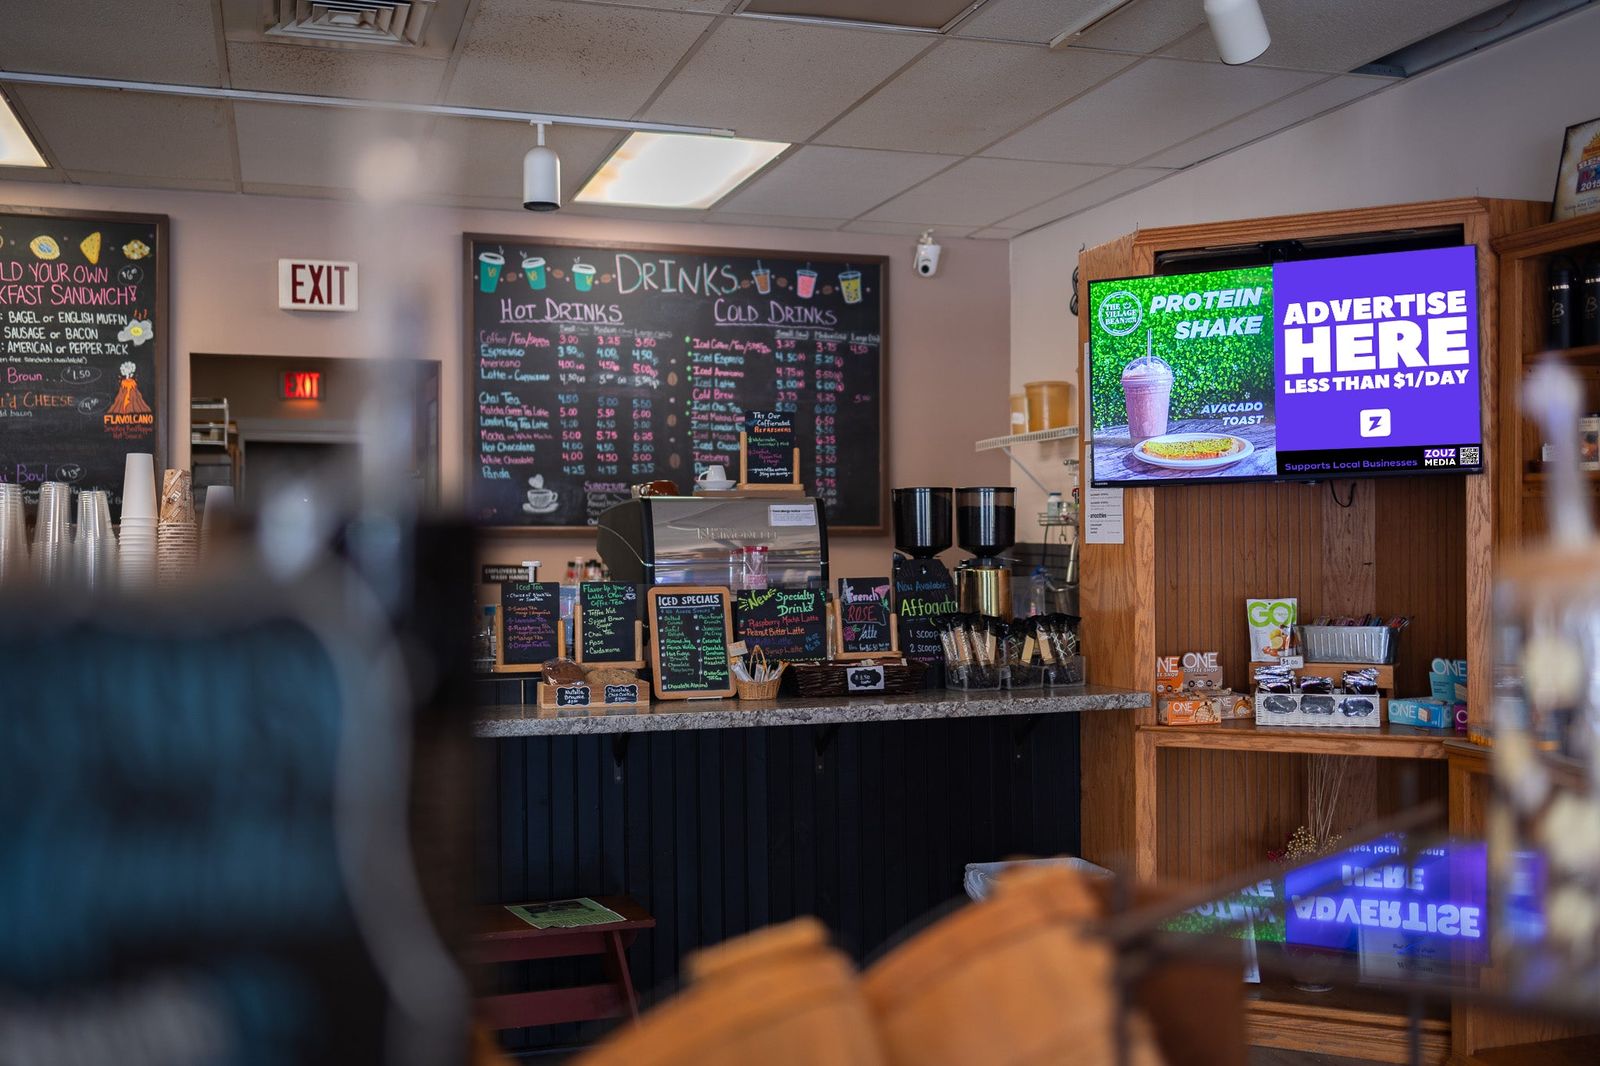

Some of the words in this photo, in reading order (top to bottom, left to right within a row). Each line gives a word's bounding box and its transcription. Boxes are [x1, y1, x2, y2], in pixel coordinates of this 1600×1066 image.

[28, 262, 71, 284] YOUR
[74, 265, 108, 284] OWN
[291, 264, 350, 306] EXIT
[1150, 287, 1262, 314] PROTEIN
[1283, 290, 1466, 326] ADVERTISE
[8, 310, 40, 324] BAGEL
[43, 315, 54, 324] or
[58, 311, 94, 324] ENGLISH
[96, 312, 128, 325] MUFFIN
[1105, 310, 1136, 318] VILLAGE
[4, 327, 46, 340] SAUSAGE
[50, 331, 61, 340] or
[66, 327, 98, 340] BACON
[1174, 316, 1263, 340] SHAKE
[8, 341, 52, 354] AMERICAN
[56, 345, 66, 354] or
[69, 342, 104, 354] PEPPER
[105, 343, 128, 355] JACK
[1284, 316, 1470, 375] HERE
[7, 367, 43, 384] Brown
[1284, 377, 1330, 394] LESS
[1332, 374, 1390, 392] THAN
[1393, 370, 1470, 390] $1/DAY
[285, 372, 320, 398] EXIT
[24, 392, 74, 408] CHEESE
[1200, 402, 1263, 414] AVACADO
[104, 415, 153, 424] FLAVOLCANO
[1222, 415, 1264, 426] TOAST
[1424, 448, 1456, 458] ZOUZ
[1285, 462, 1330, 472] Supports
[1333, 460, 1360, 470] Local
[1363, 458, 1418, 468] Businesses
[1424, 458, 1456, 466] MEDIA
[658, 596, 678, 606] ICED
[682, 594, 720, 604] SPECIALS
[776, 590, 814, 605] Specialty
[777, 602, 814, 616] Drinks
[848, 605, 876, 622] ROSE
[902, 595, 958, 626] Affogato
[910, 644, 916, 652] 2
[1157, 656, 1180, 672] NE
[1183, 652, 1218, 668] ONE
[1432, 658, 1467, 676] ONE
[1173, 702, 1193, 712] ONE
[1390, 702, 1417, 718] ONE
